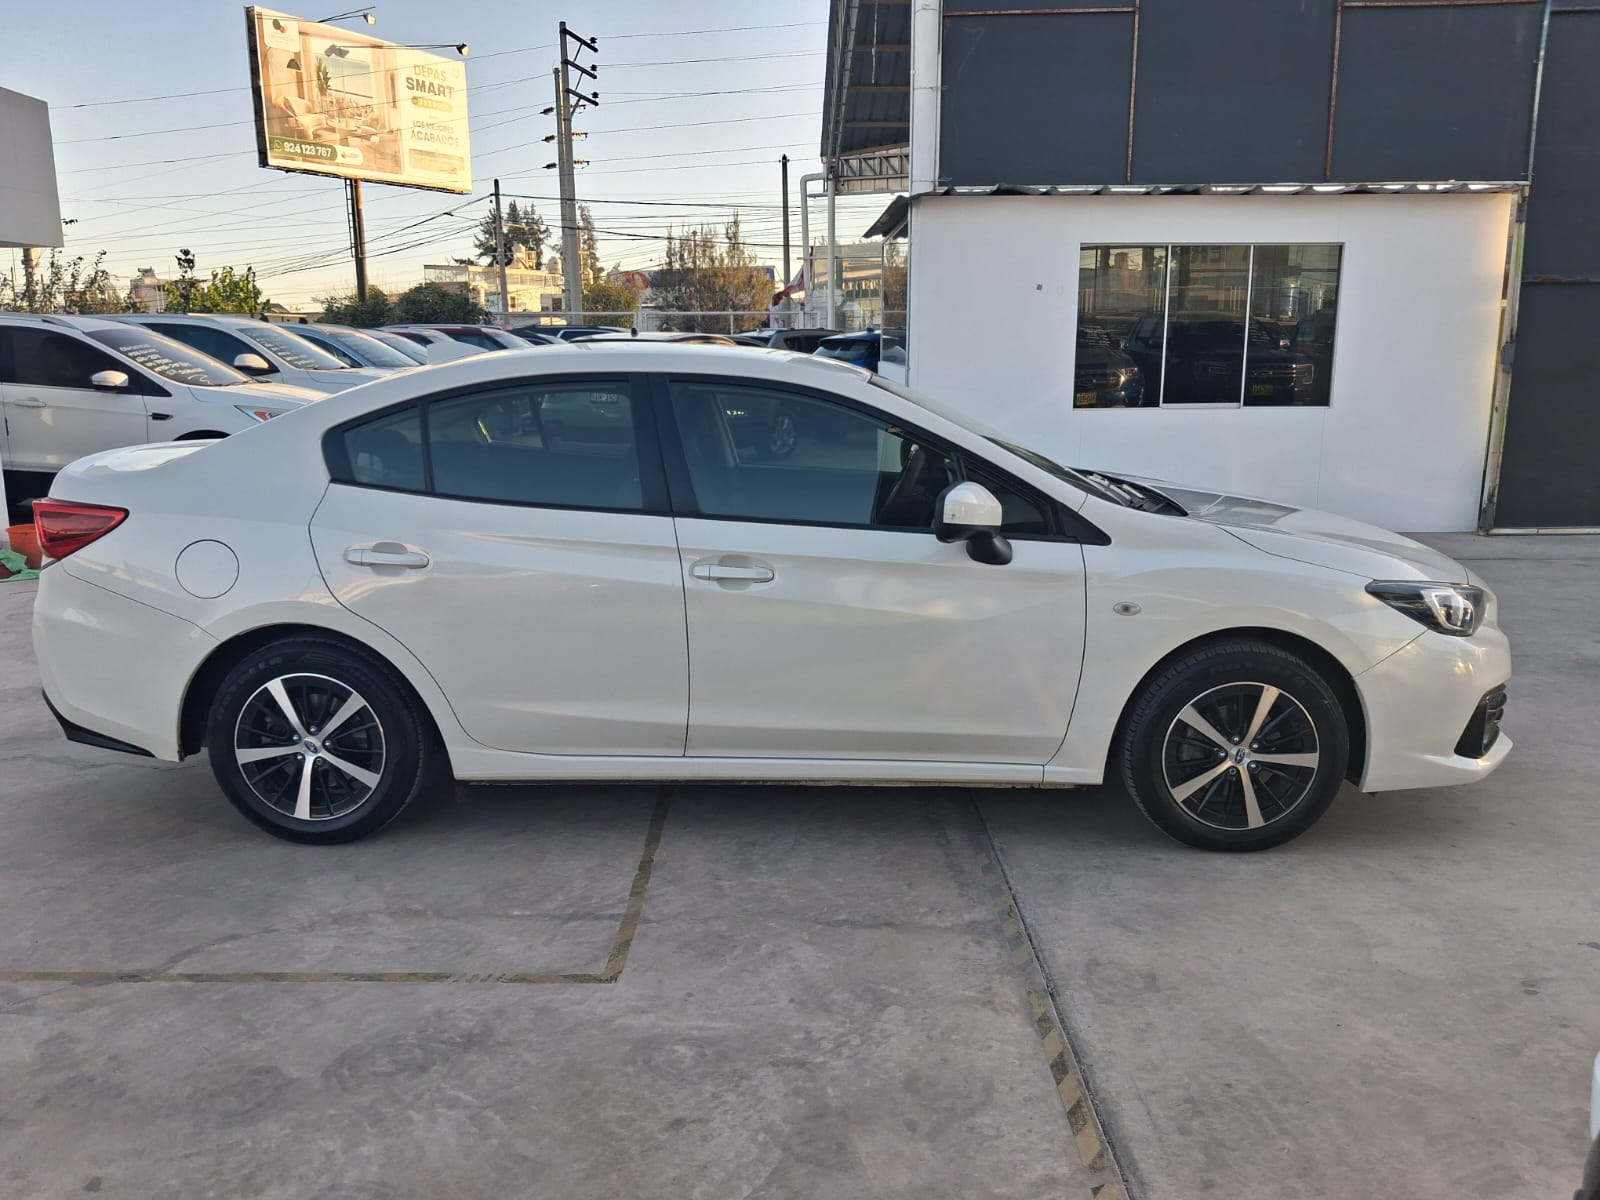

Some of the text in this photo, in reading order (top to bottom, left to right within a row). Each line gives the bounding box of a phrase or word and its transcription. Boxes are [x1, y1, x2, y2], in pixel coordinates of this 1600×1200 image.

[413, 64, 447, 82] DEPAS
[406, 77, 455, 99] SMART
[283, 141, 301, 154] 924
[301, 144, 316, 156] 123
